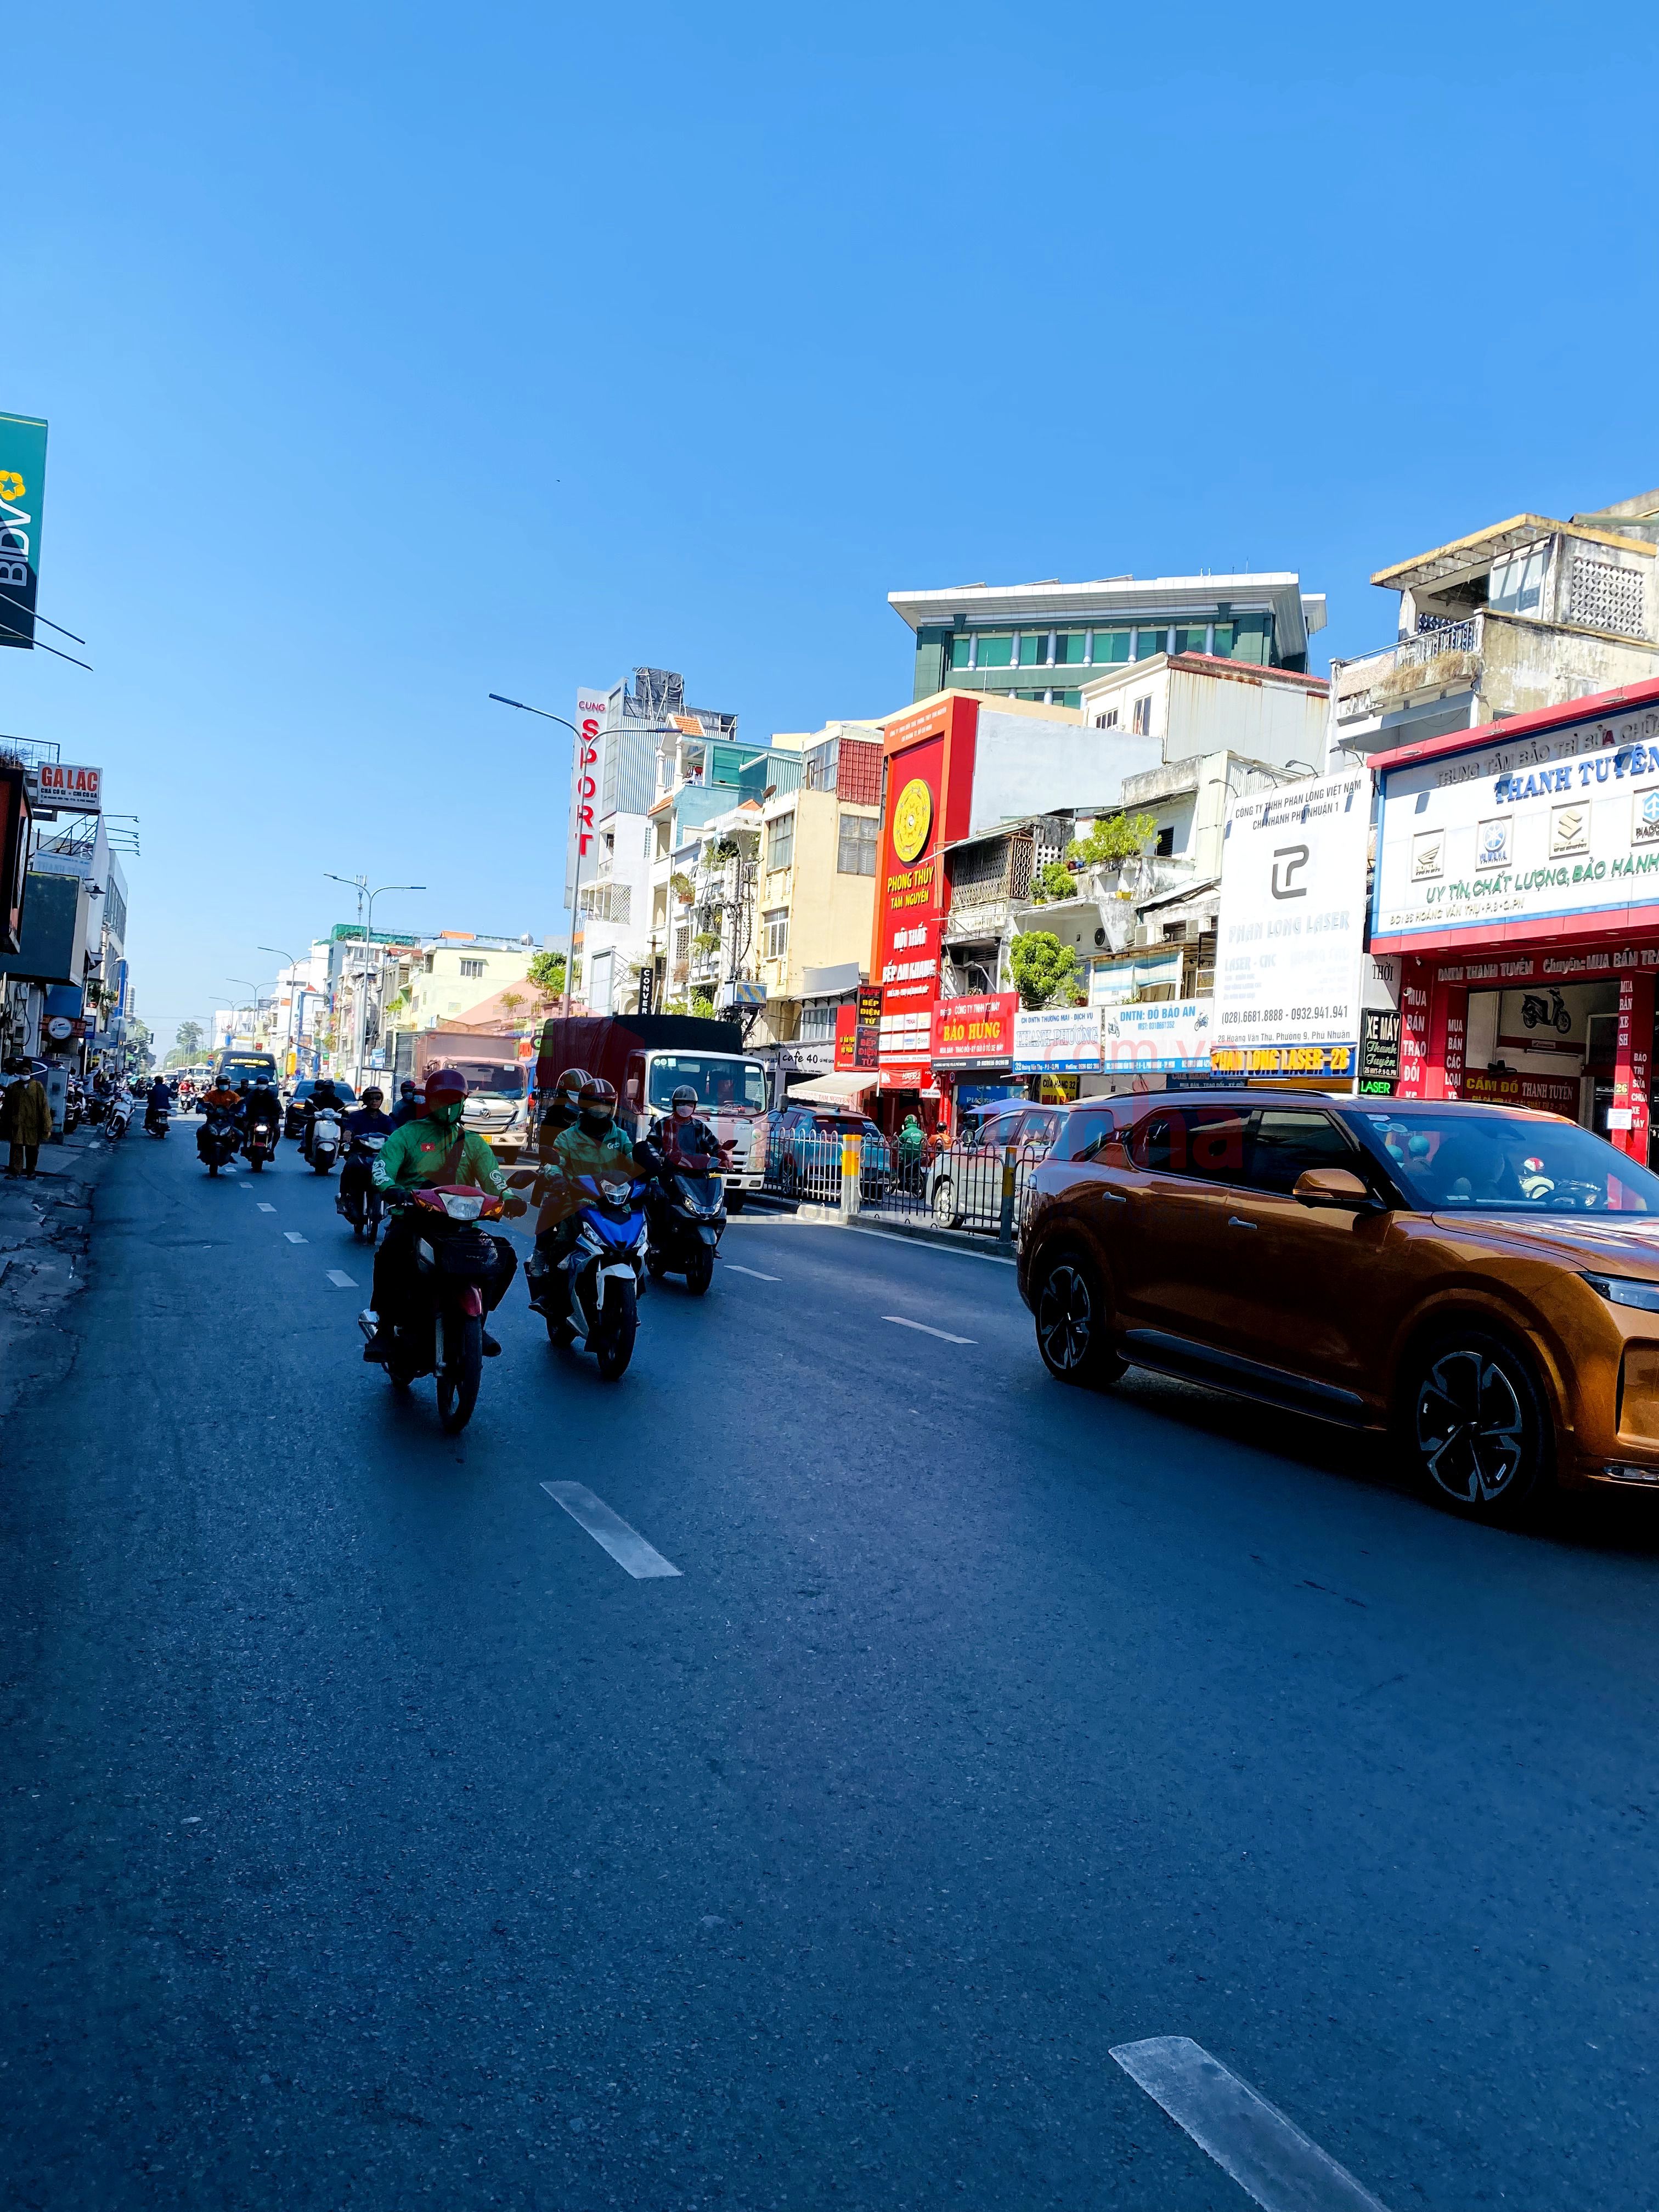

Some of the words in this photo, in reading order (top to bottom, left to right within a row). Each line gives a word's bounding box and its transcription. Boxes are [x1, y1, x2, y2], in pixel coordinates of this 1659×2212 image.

[0, 498, 31, 586] BIDV
[579, 701, 605, 712] CUNG
[1435, 763, 1480, 788] TRUNG
[1485, 753, 1515, 774] TÂM
[1518, 741, 1550, 769] BẢO
[1554, 733, 1579, 759] TRÌ
[41, 765, 64, 788] GÀ
[1494, 766, 1572, 804] THANH
[575, 719, 600, 856] SPORT
[1235, 806, 1253, 819] CÔNG
[1256, 804, 1263, 814] TY
[1265, 799, 1282, 811] TNHH
[1284, 794, 1303, 807] PHAN
[1306, 789, 1324, 803] LONG
[1327, 783, 1342, 798] VIỆT
[1344, 780, 1362, 793] NAM
[1308, 802, 1333, 817] NHUẬN
[1335, 802, 1339, 812] 1
[888, 872, 912, 893] PHONG
[914, 862, 934, 887] THỦY
[1426, 886, 1446, 904] UY
[1572, 856, 1606, 883] BẢO
[891, 896, 903, 910] TAM
[906, 888, 929, 906] NGUYÊN
[1229, 922, 1263, 944] PHAN
[1267, 917, 1301, 938] LONG
[1306, 910, 1350, 934] LASER
[1613, 948, 1639, 967] BÁN
[1373, 962, 1393, 981] THỜI
[1466, 964, 1498, 979] THANH
[641, 969, 650, 1014] CONVER
[1620, 981, 1633, 992] MUA
[862, 998, 879, 1007] BẾP
[1408, 990, 1426, 1007] MUA
[1620, 995, 1633, 1011] BÁN
[955, 1003, 966, 1015] CÔNG
[967, 1005, 974, 1014] TY
[974, 1002, 984, 1013] TNHH
[1120, 1011, 1145, 1022] DNTN:
[1162, 1005, 1180, 1019] BẢO
[1182, 1006, 1196, 1017] AN
[1222, 1009, 1283, 1025] (028).6681.8888
[1291, 1005, 1348, 1020] 0932.941.941
[944, 1018, 964, 1041] BẢO
[968, 1019, 1000, 1040] HƯNG
[1367, 1016, 1379, 1040] XE
[1380, 1014, 1400, 1041] MÁY
[1406, 1011, 1425, 1031] BÁN
[1448, 1019, 1463, 1032] MUA
[1620, 1016, 1629, 1029] XE
[860, 1037, 877, 1047] BẾP
[1053, 1024, 1098, 1046] PHƯƠNG
[1227, 1034, 1246, 1043] Hoàng
[1448, 1035, 1463, 1051] BÁN
[1619, 1034, 1628, 1046] SH
[1367, 1041, 1397, 1054] Thanh
[1403, 1040, 1426, 1057] TRAO
[783, 1051, 804, 1064] cafe
[806, 1054, 818, 1063] 40
[1246, 1049, 1280, 1071] LONG
[1447, 1053, 1461, 1069] CÁC
[1015, 1062, 1022, 1071] 32
[1404, 1058, 1420, 1082] ĐỔI
[1043, 1076, 1052, 1088] CỬA
[1361, 1081, 1390, 1094] LASER
[1445, 1072, 1461, 1088] LOẠI
[1466, 1076, 1497, 1091] CẦM
[1501, 1080, 1518, 1093] ĐỒ
[1522, 1082, 1547, 1098] THANH
[1616, 1084, 1628, 1093] 26
[1632, 1106, 1640, 1115] XE
